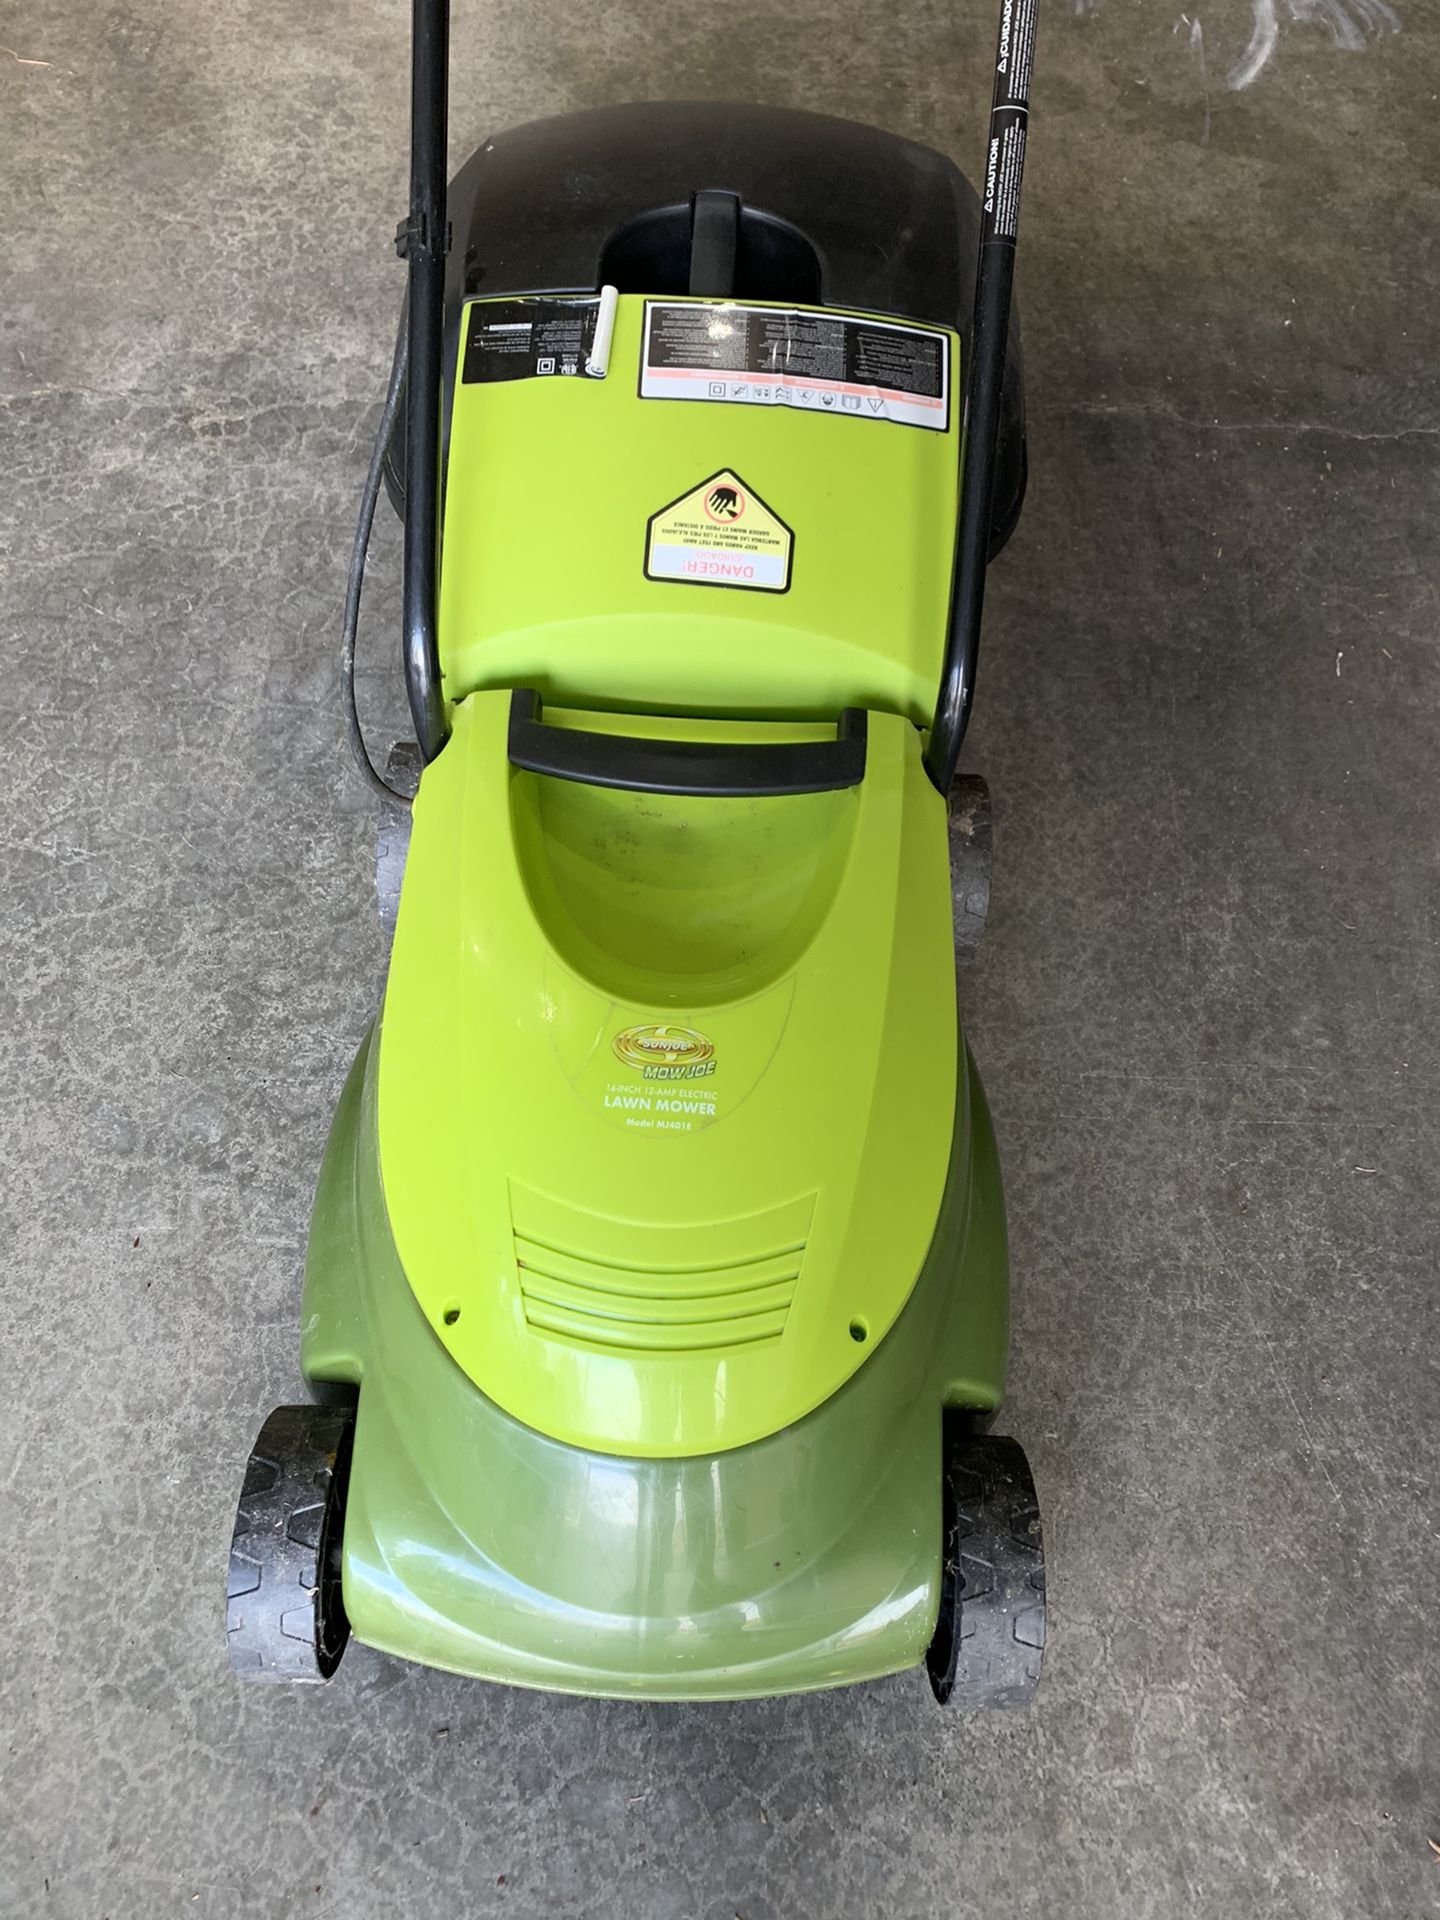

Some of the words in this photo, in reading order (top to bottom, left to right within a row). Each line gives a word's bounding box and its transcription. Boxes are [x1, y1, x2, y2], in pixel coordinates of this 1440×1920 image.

[986, 137, 999, 198] CAUTION!
[661, 528, 688, 536] ALEJADOS
[751, 537, 780, 545] MANTENGA
[682, 560, 754, 578] DANGER!
[643, 1065, 685, 1080] MOW
[685, 1060, 717, 1079] JOE
[606, 1083, 641, 1094] 14-INCH
[644, 1085, 678, 1096] 12-AMP
[678, 1088, 718, 1099] ELECTRIC
[604, 1095, 651, 1111] LAWN
[655, 1099, 717, 1116] MOWER
[626, 1118, 654, 1128] Model
